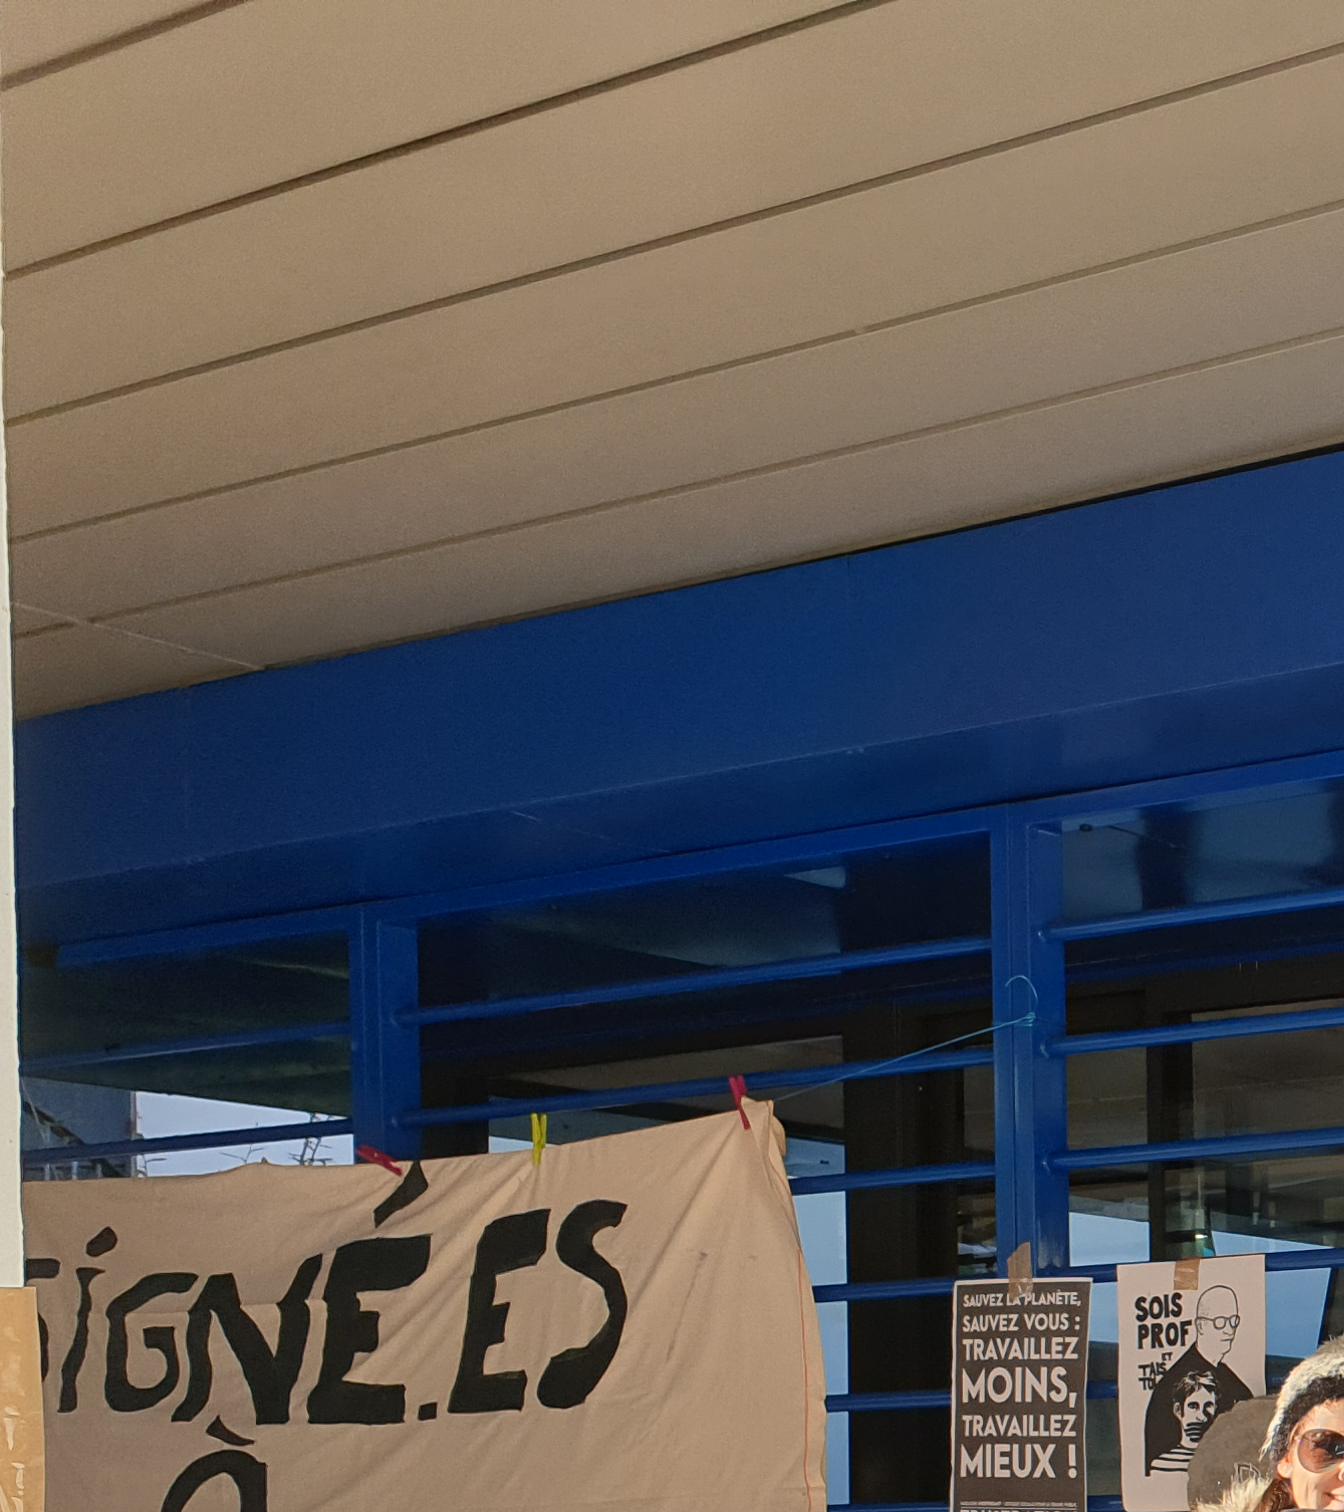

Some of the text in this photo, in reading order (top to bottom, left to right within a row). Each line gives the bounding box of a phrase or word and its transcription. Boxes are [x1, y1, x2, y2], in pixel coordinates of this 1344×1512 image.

[963, 1293, 1003, 1307] SAUVEZ
[1006, 1293, 1021, 1306] LA
[1135, 1292, 1183, 1322] SOIS
[962, 1313, 1019, 1332] SAUVEZ
[1024, 1312, 1069, 1330] VOUS
[1137, 1320, 1192, 1349] PROF
[962, 1336, 1079, 1360] TRAVAILLEZ
[1161, 1352, 1173, 1360] ET
[1138, 1361, 1167, 1377] TAIS
[962, 1366, 1077, 1408] MOINS,
[962, 1414, 1077, 1437] TRAVAILLEZ
[960, 1443, 1056, 1478] MIEUX
